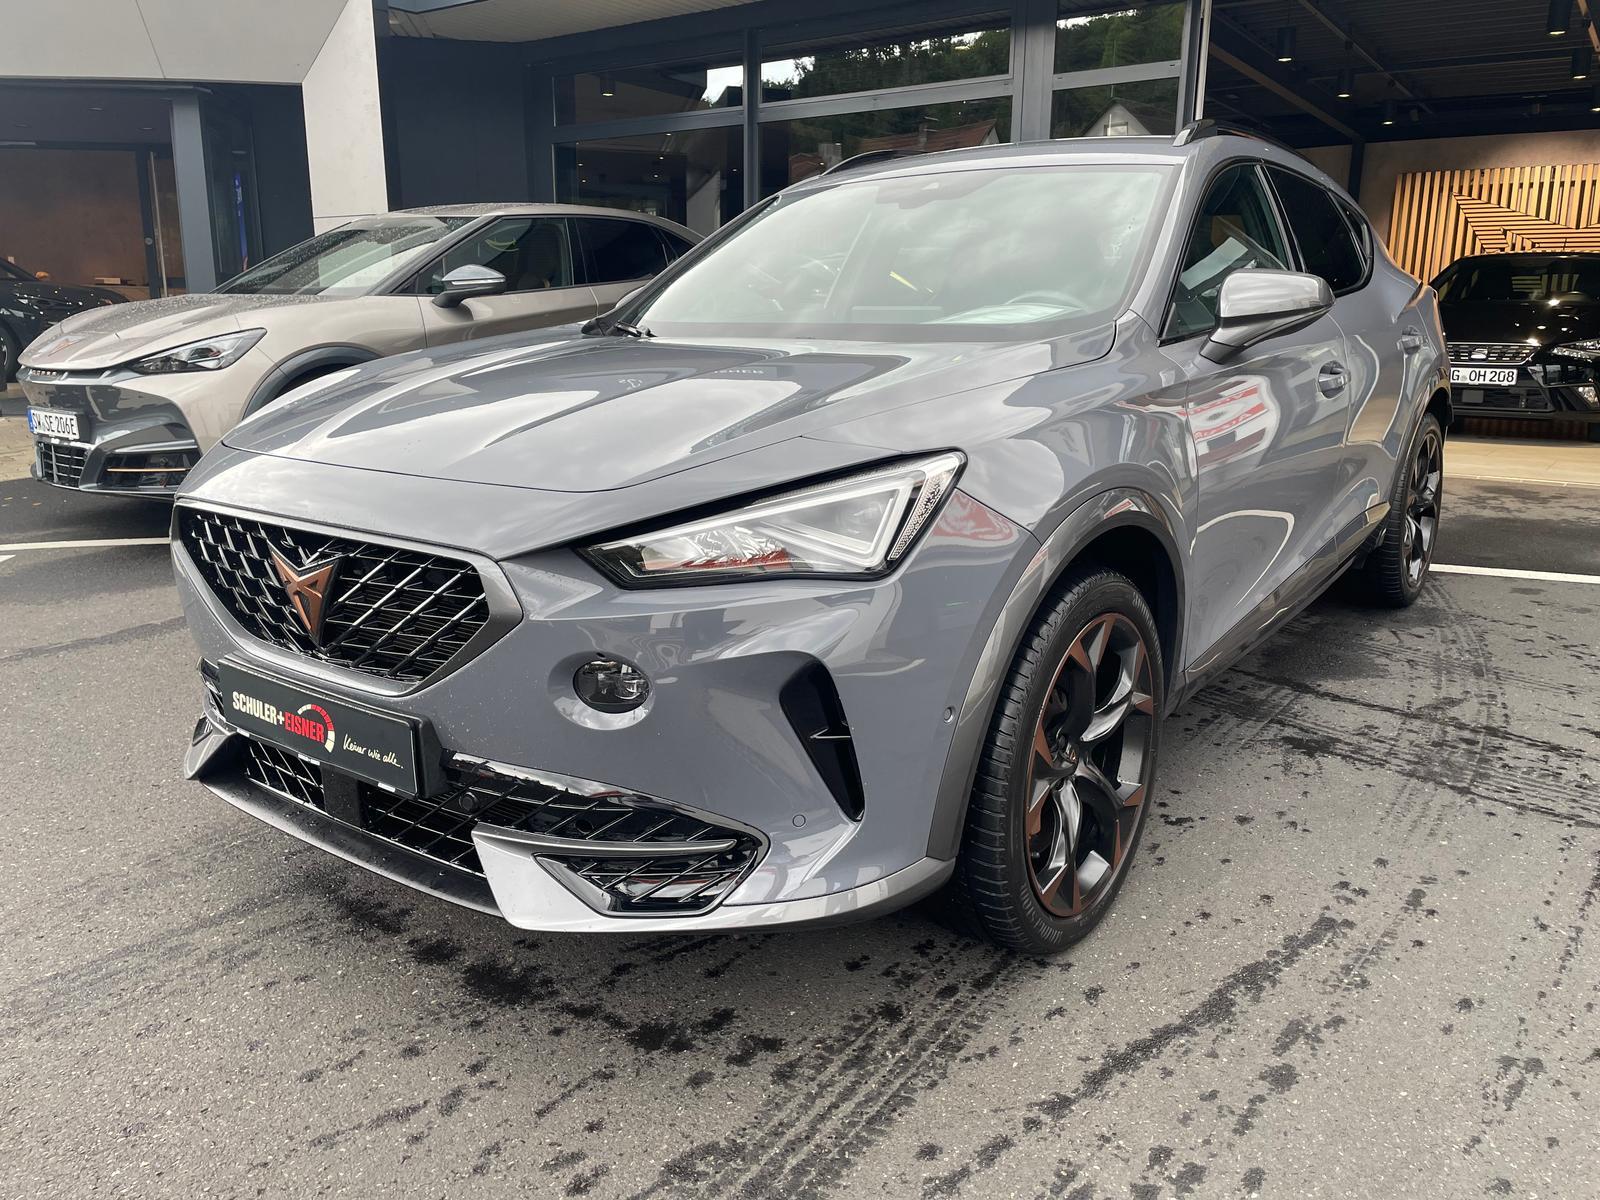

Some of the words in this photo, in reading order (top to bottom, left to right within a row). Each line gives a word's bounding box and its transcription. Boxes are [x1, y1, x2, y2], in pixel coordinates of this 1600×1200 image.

[1469, 370, 1487, 382] OH
[1489, 371, 1515, 383] 208
[45, 414, 55, 432] SE
[55, 416, 77, 435] 206E
[343, 733, 367, 755] Keiner
[367, 749, 381, 761] wie
